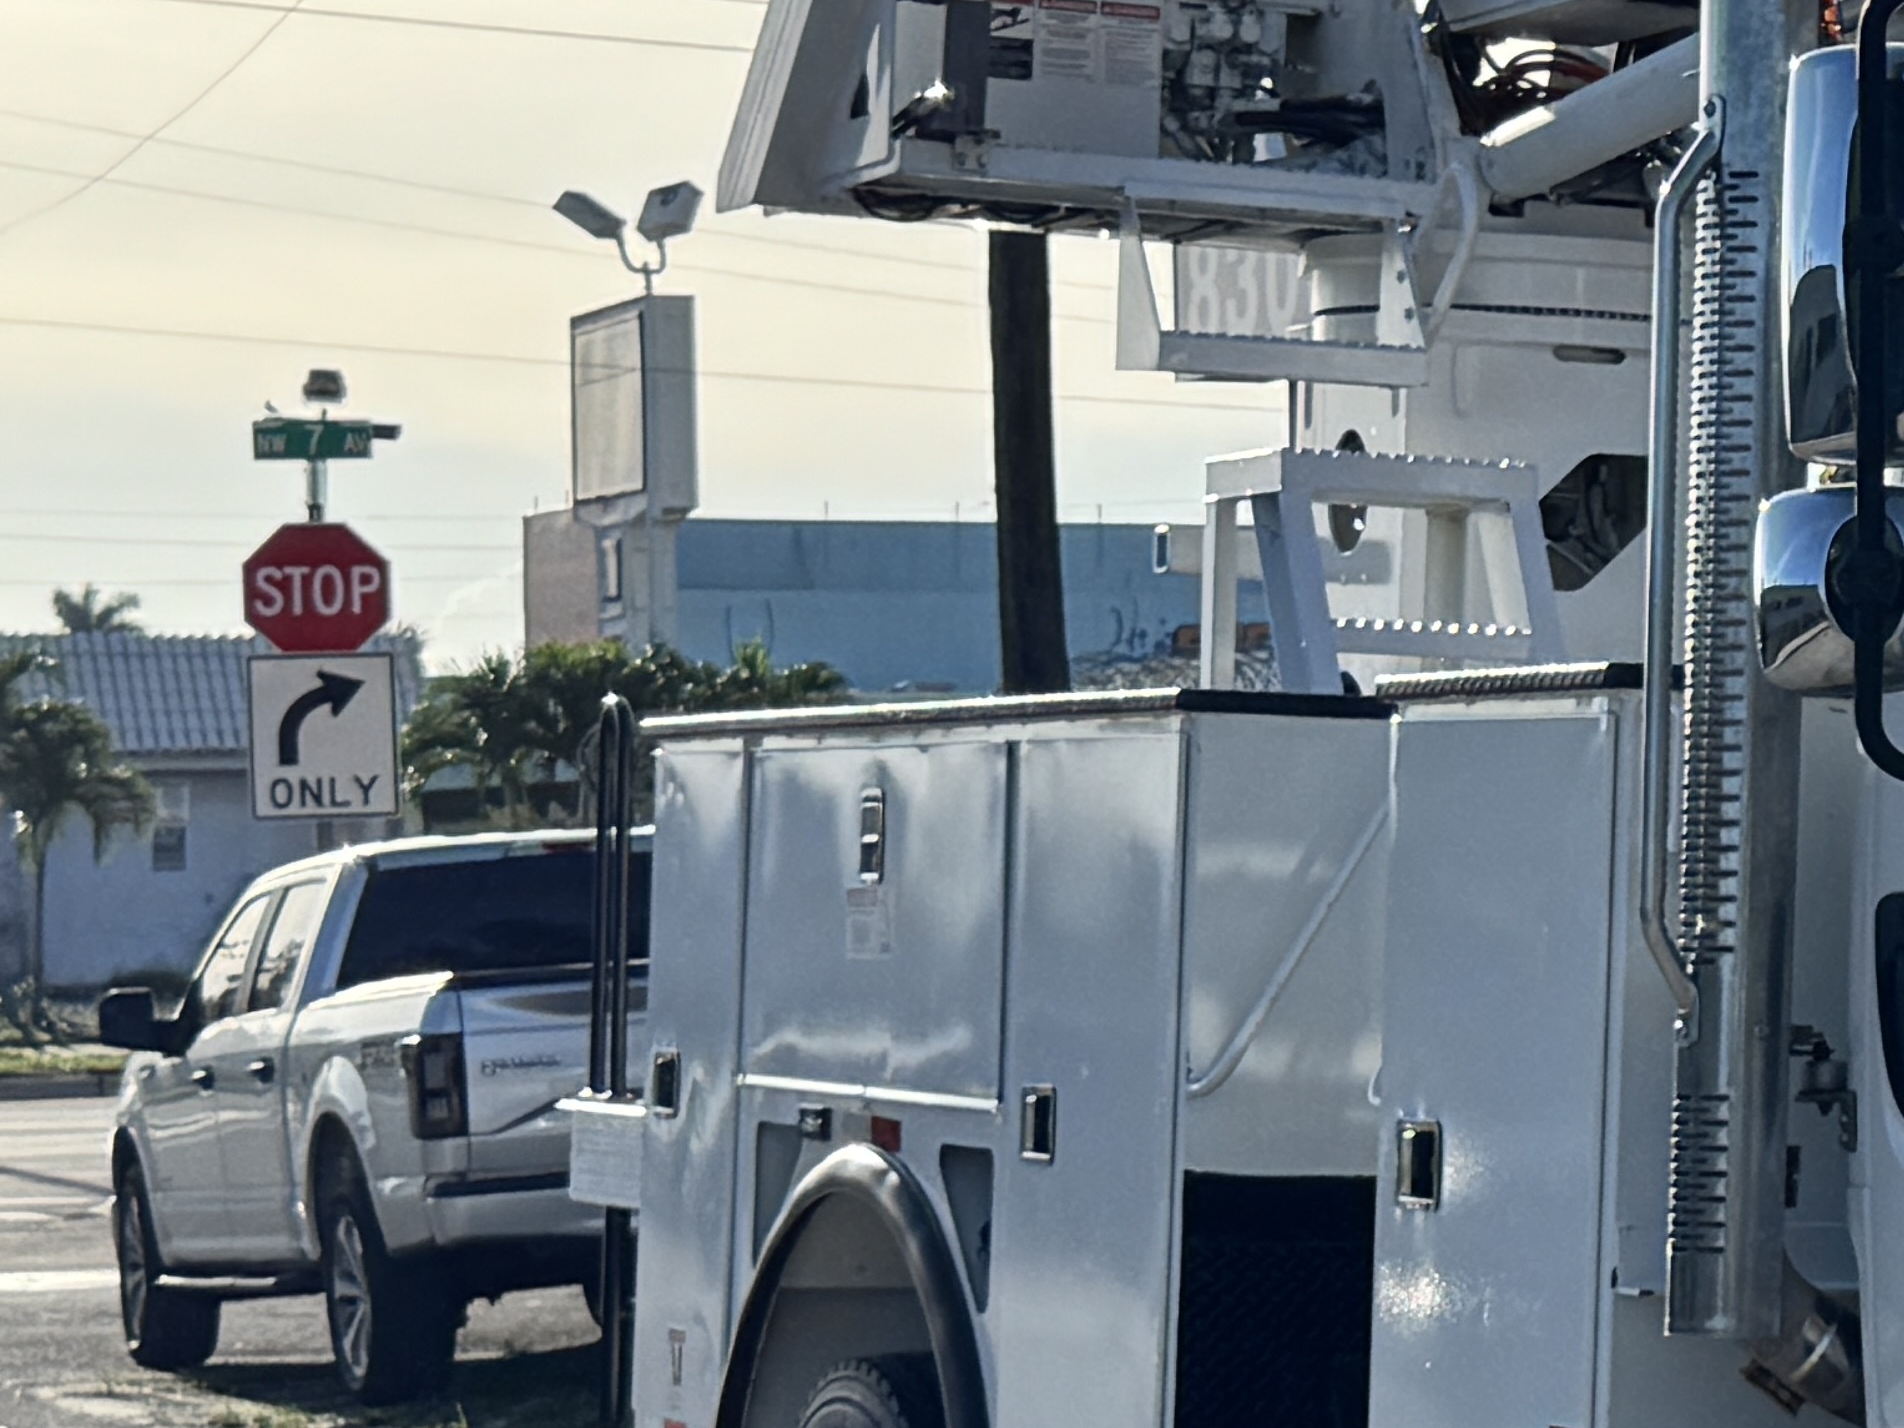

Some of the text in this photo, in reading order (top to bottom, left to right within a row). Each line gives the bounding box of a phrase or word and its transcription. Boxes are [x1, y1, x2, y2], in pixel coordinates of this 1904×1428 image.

[303, 424, 324, 455] 7
[254, 564, 381, 617] STOP
[269, 774, 380, 810] ONLY
